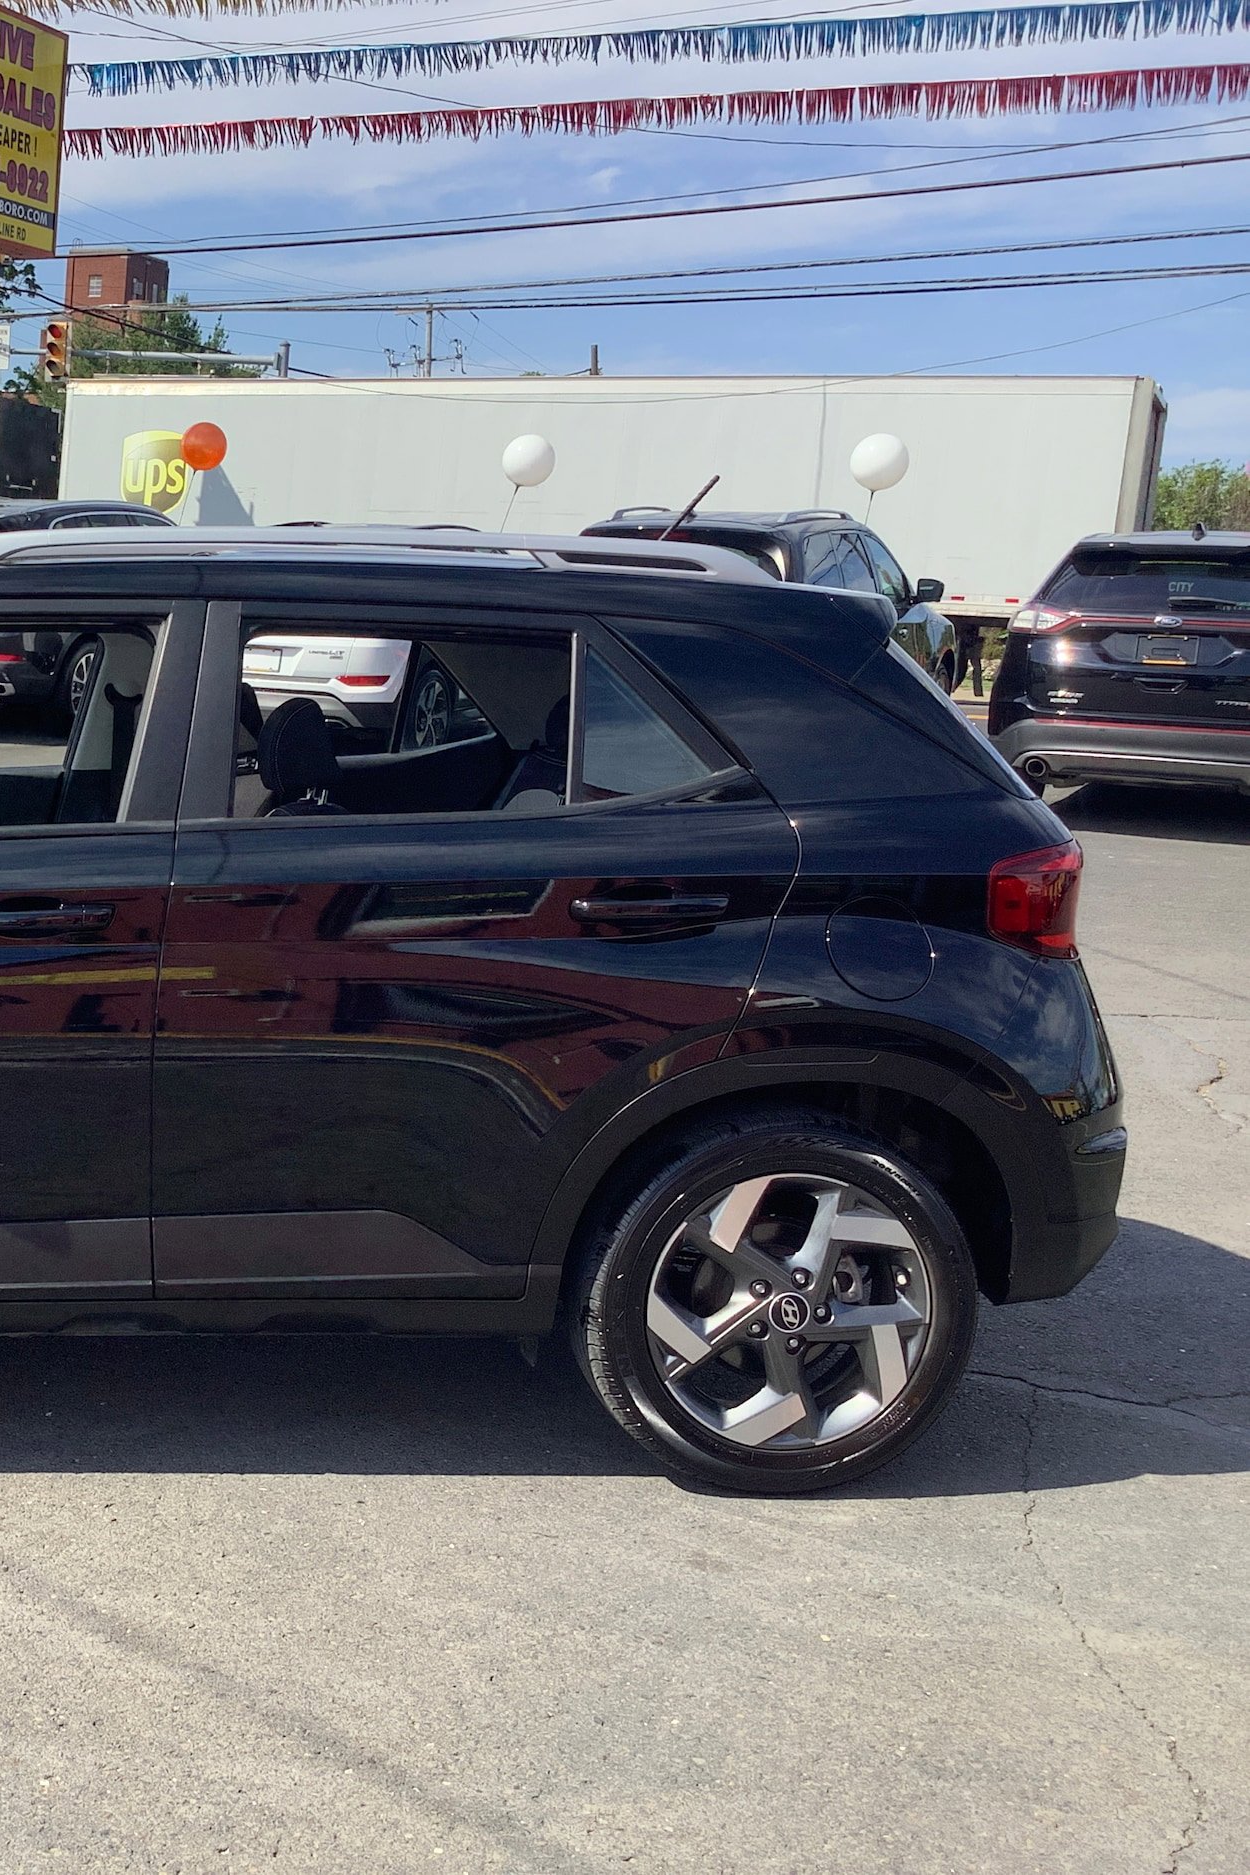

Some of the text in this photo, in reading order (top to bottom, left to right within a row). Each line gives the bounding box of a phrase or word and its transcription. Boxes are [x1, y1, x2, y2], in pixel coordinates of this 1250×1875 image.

[16, 227, 27, 241] RD
[125, 458, 185, 507] ups
[1168, 581, 1194, 592] CITY
